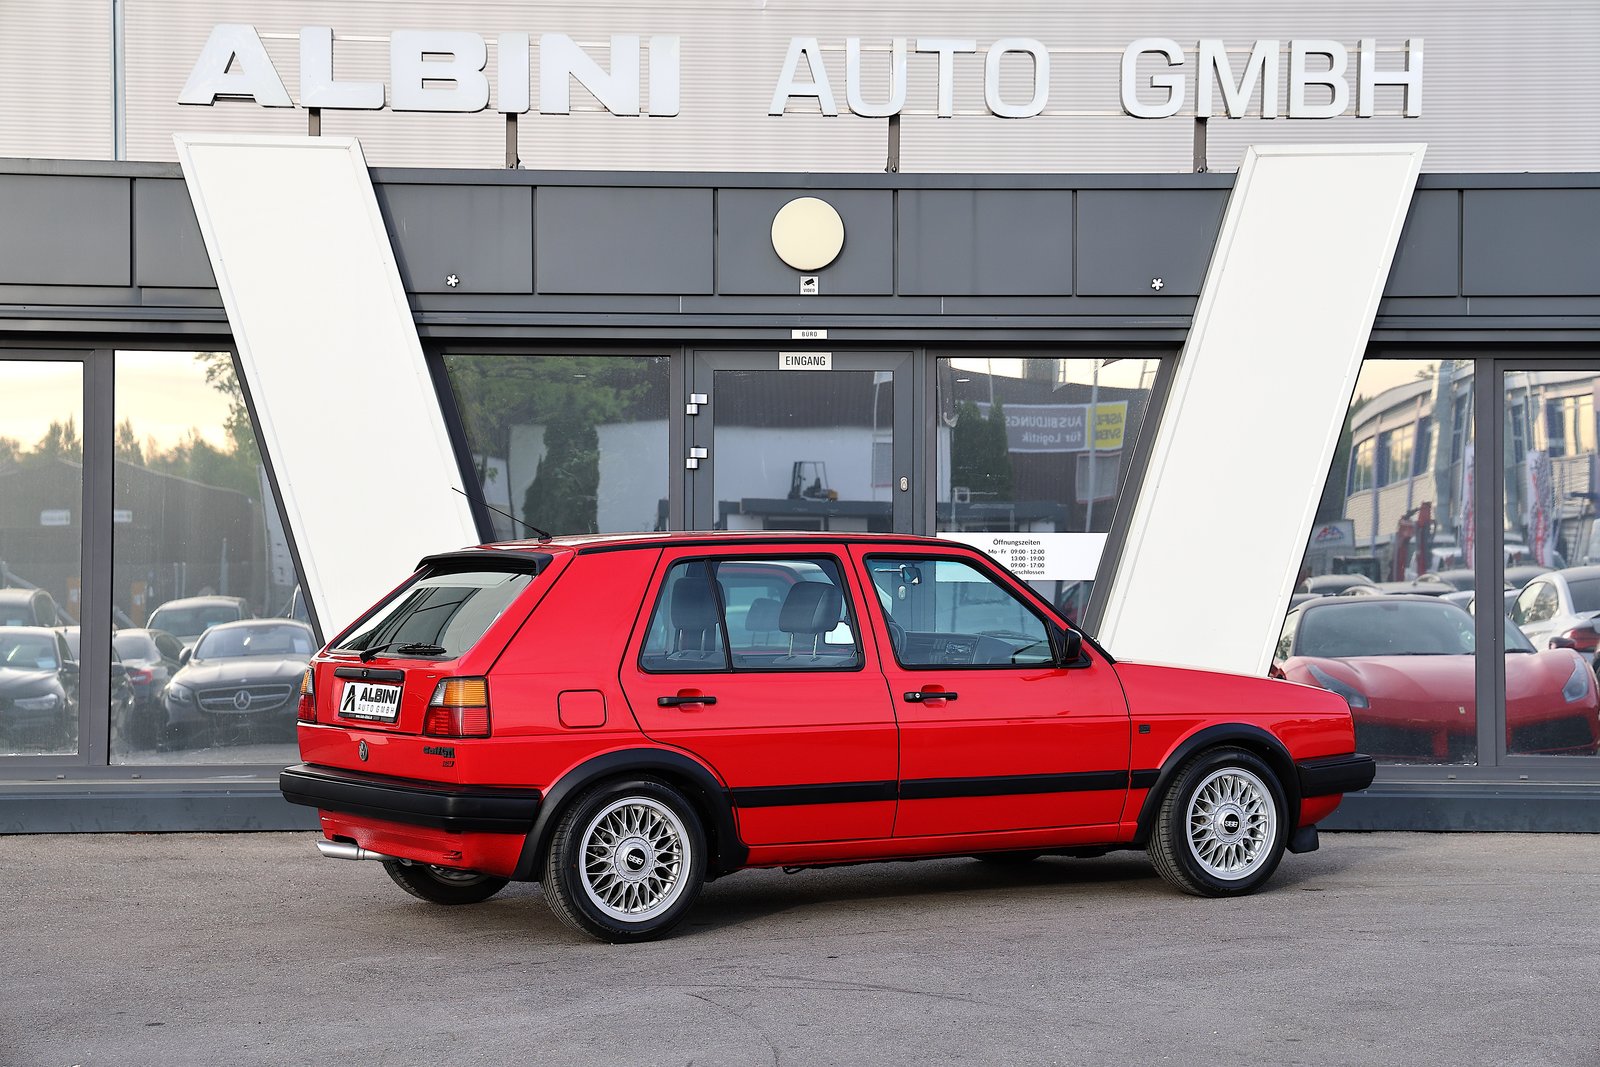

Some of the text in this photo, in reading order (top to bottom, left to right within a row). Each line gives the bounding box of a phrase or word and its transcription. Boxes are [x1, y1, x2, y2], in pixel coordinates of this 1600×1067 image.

[177, 24, 1424, 119] ALBINI AUTO GMBH
[785, 355, 826, 366] EINGANG
[993, 538, 1041, 546] Öffnungszeiten
[360, 687, 398, 704] ALBINI
[357, 703, 395, 714] AUTO GMBH
